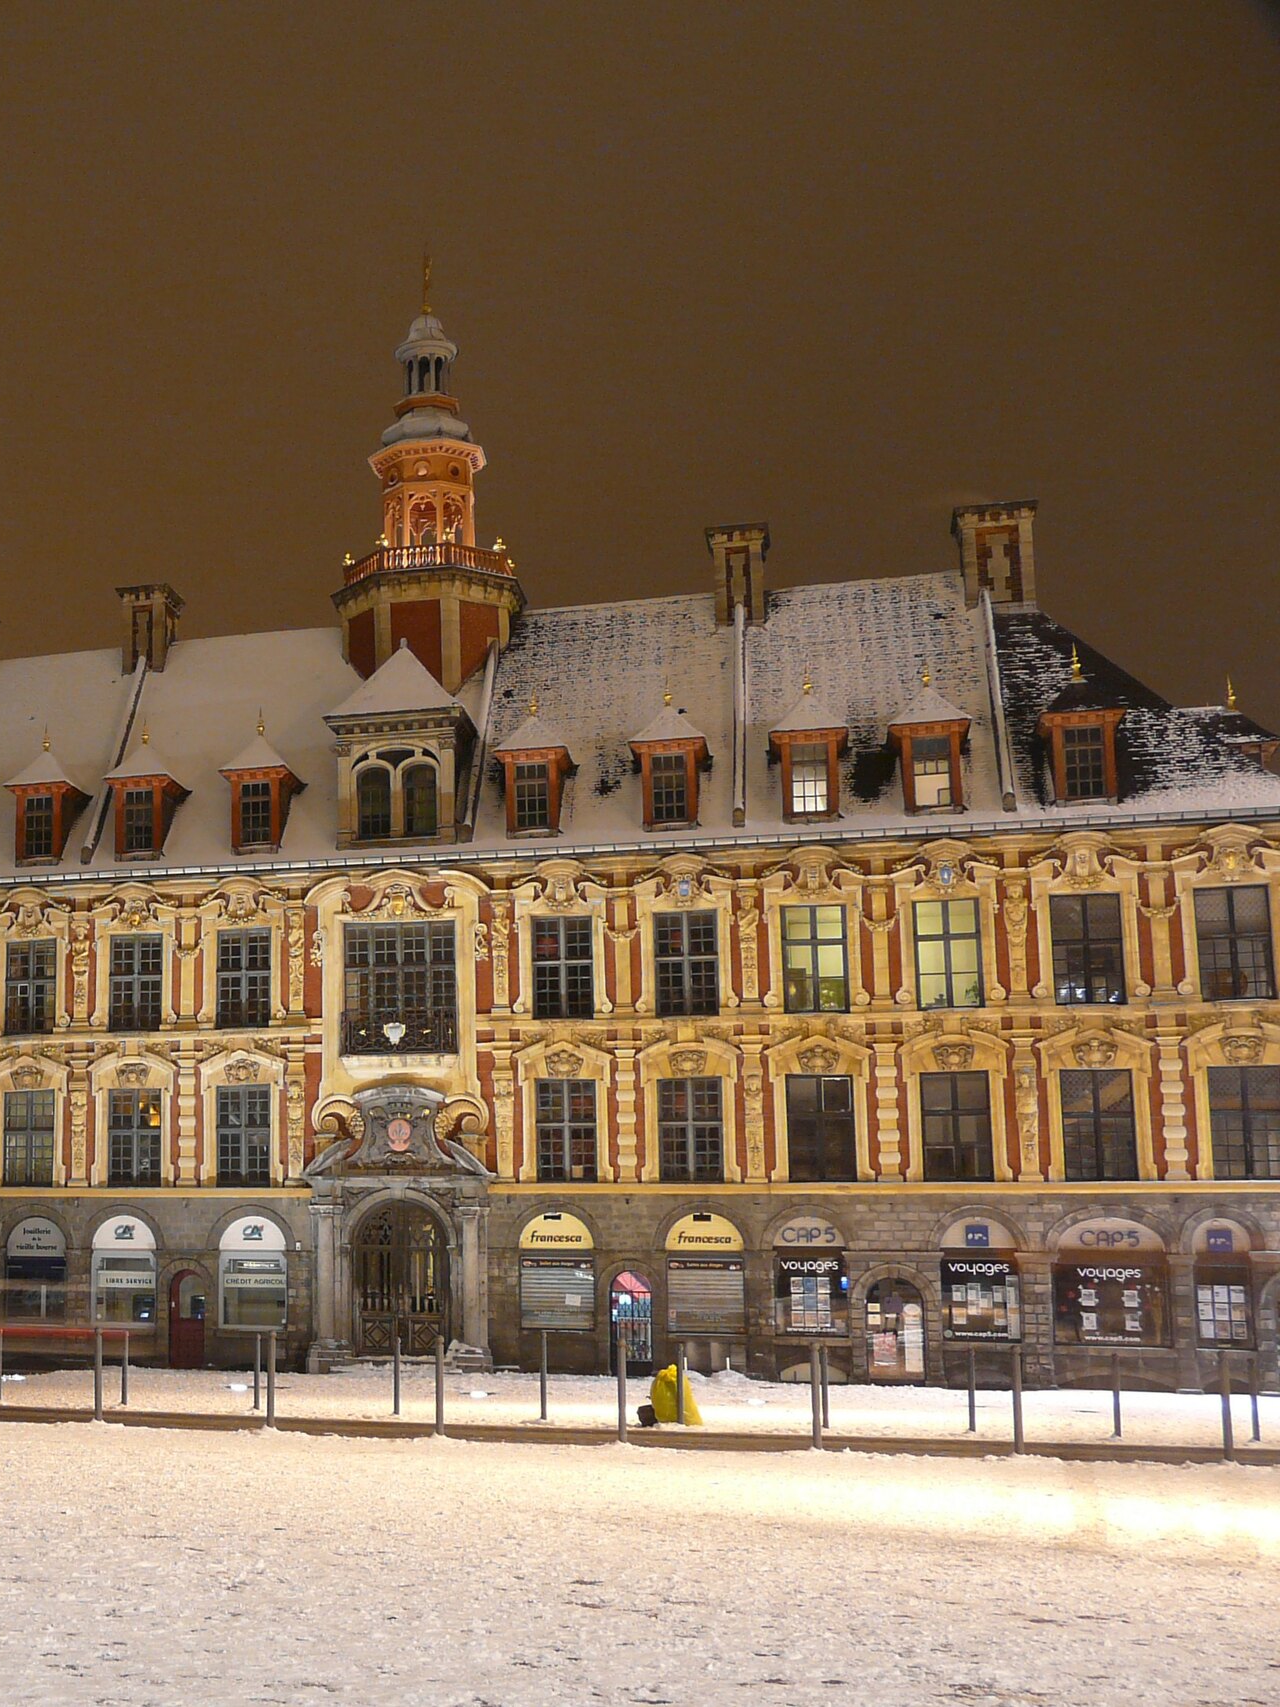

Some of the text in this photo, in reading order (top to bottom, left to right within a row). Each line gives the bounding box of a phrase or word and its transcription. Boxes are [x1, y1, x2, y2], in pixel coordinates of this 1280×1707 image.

[530, 1230, 582, 1243] francesca
[677, 1231, 732, 1244] francesca
[781, 1226, 836, 1243] CAP 5
[1080, 1230, 1140, 1247] CAP 5
[781, 1260, 839, 1274] voyages
[948, 1262, 1010, 1276] voyages
[253, 1278, 285, 1286] AGRICOL
[1077, 1267, 1141, 1283] voyages
